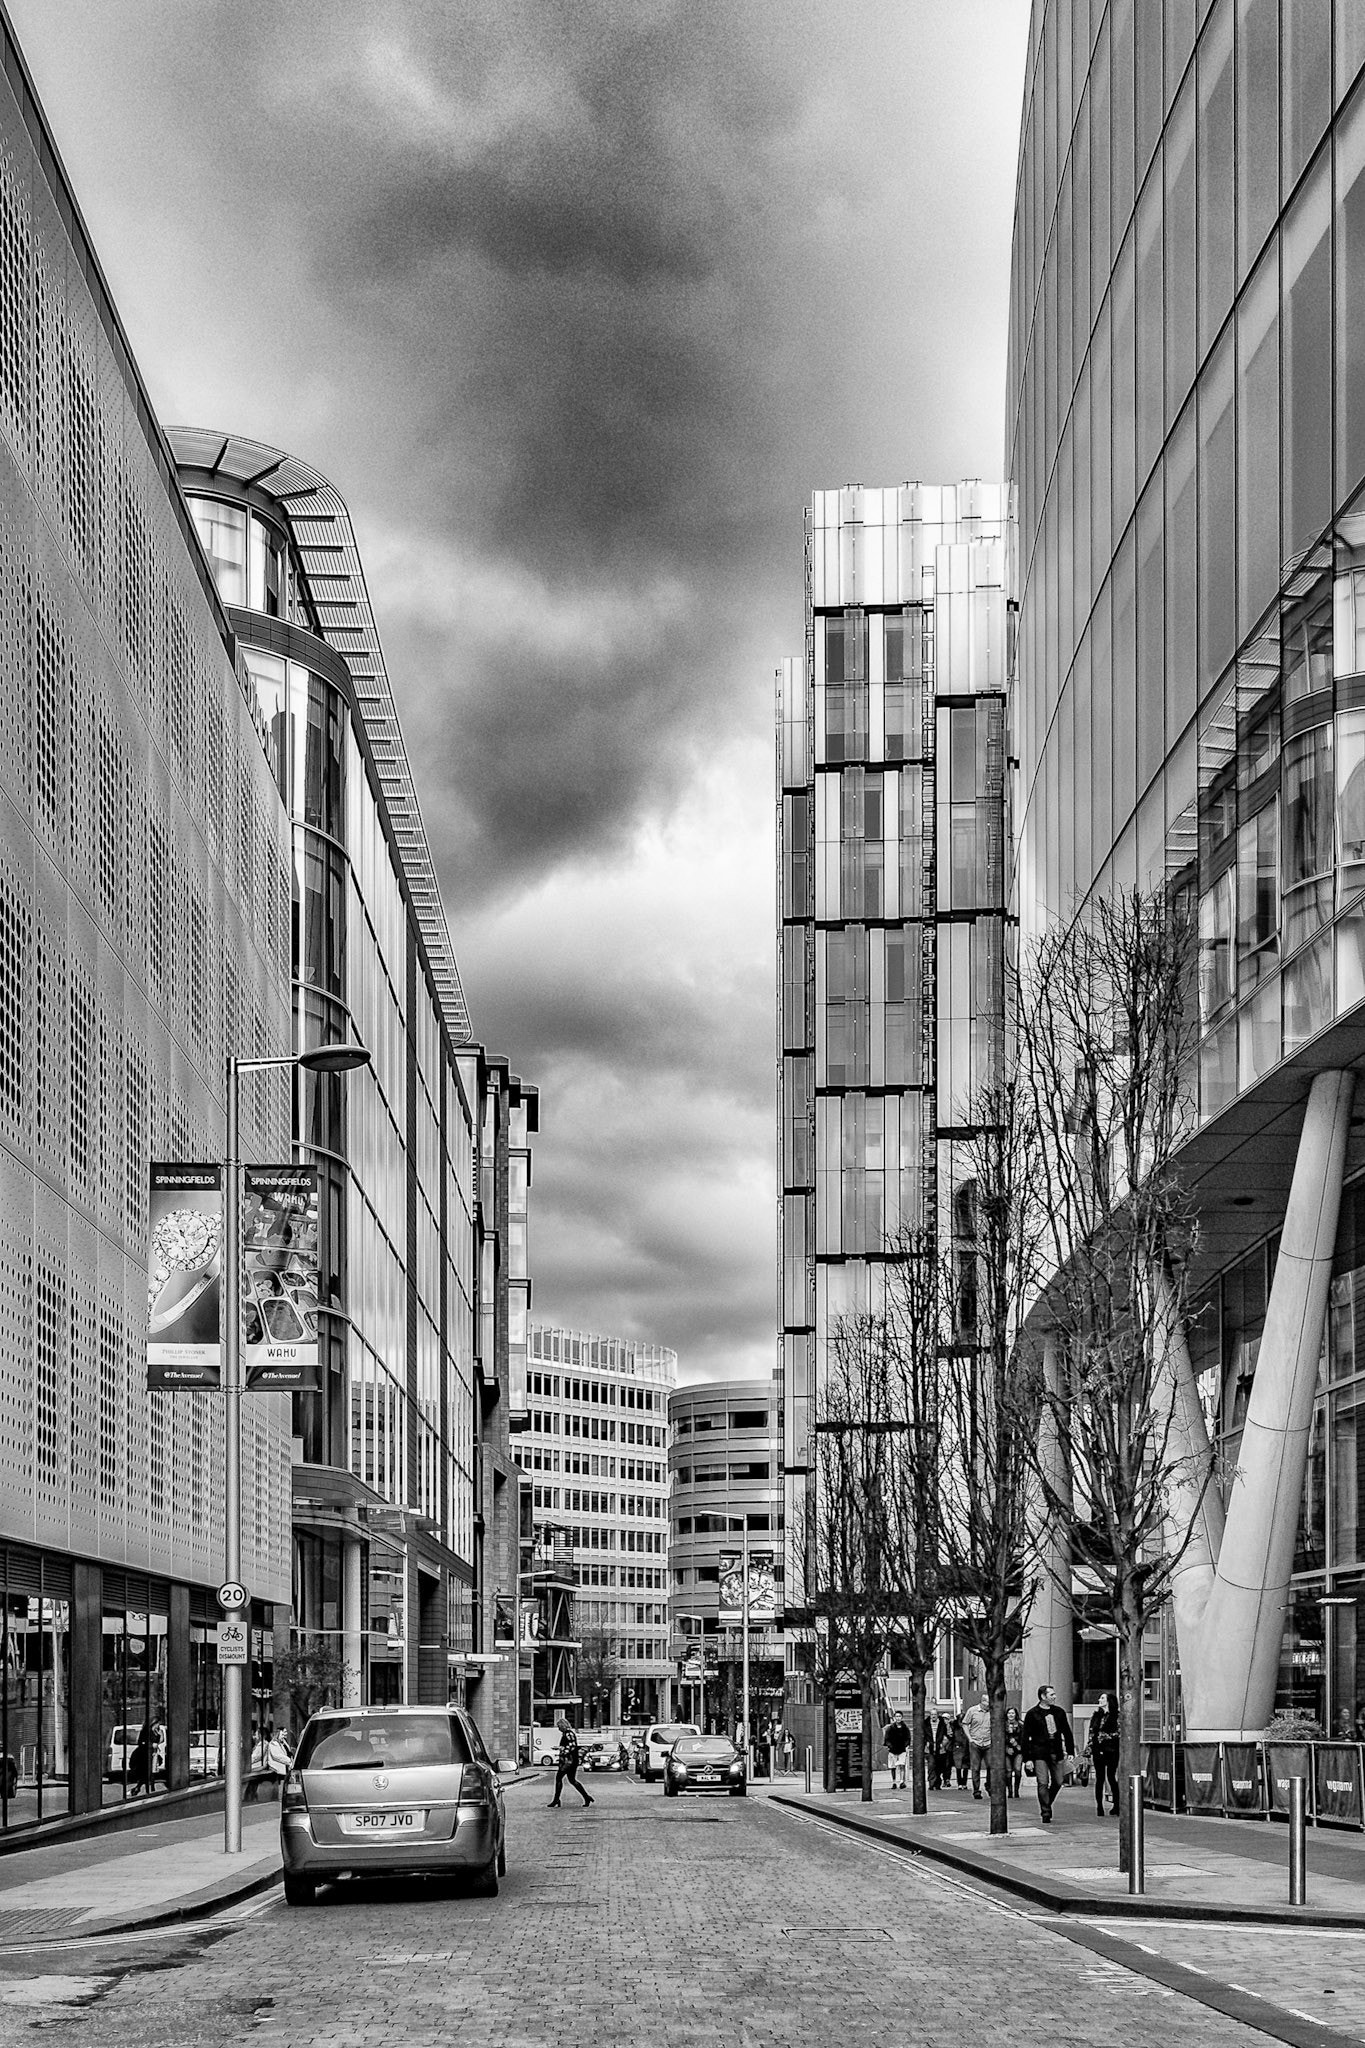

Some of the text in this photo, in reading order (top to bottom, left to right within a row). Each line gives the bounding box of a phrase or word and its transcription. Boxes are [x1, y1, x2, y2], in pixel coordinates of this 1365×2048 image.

[155, 1175, 215, 1184] SPINNINGFIELDS
[251, 1177, 312, 1186] SPINNINGFIELDS
[267, 1348, 297, 1358] WAHU
[222, 1589, 243, 1602] 20
[355, 1814, 413, 1827] SP07 JVO
